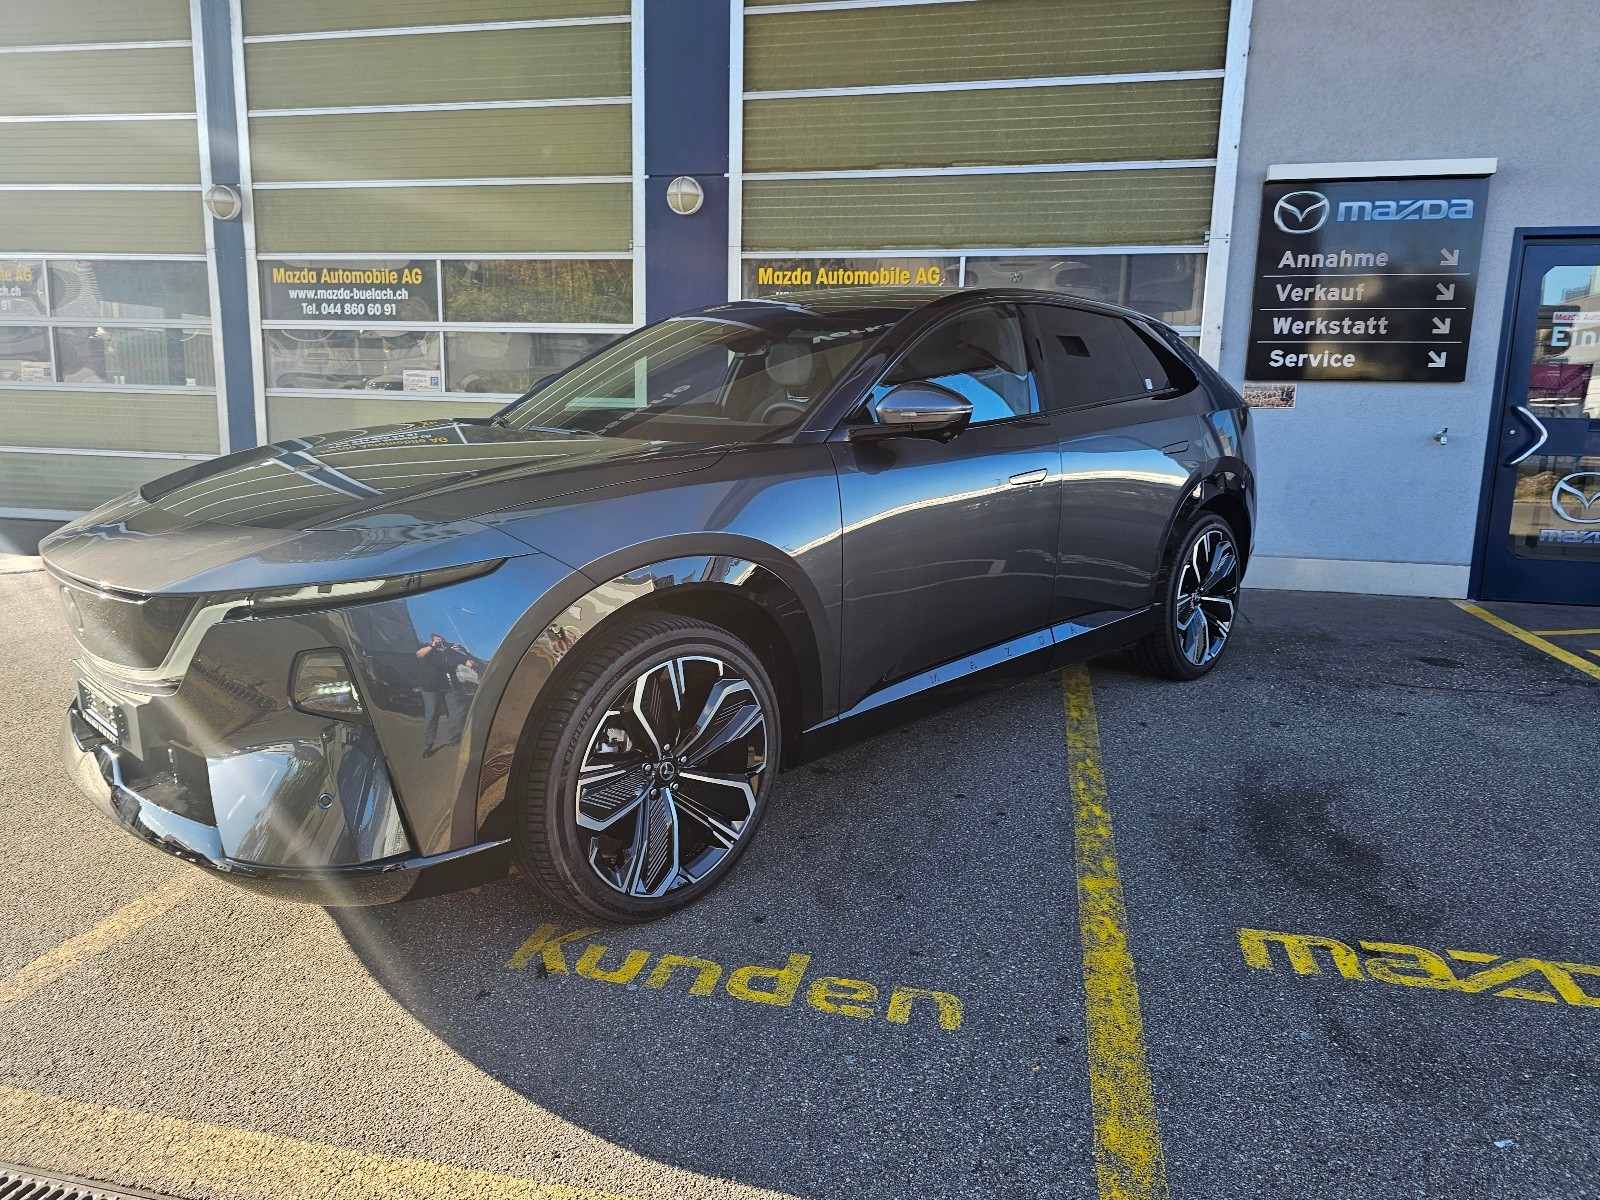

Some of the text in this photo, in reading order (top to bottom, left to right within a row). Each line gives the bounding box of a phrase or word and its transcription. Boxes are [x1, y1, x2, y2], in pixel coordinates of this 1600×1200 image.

[1277, 249, 1389, 269] Annahme
[272, 267, 423, 285] Mazda Automobile AG
[758, 266, 941, 285] Mazda Automobile AG
[288, 287, 409, 301] www.mazda-buelach.ch
[1275, 283, 1366, 302] Verkauf
[301, 302, 396, 316] Tel. 044 860 60 91
[1272, 317, 1389, 335] Werkstatt
[1551, 326, 1600, 347] Ein
[1268, 350, 1356, 368] Service
[503, 923, 964, 1031] Kunden
